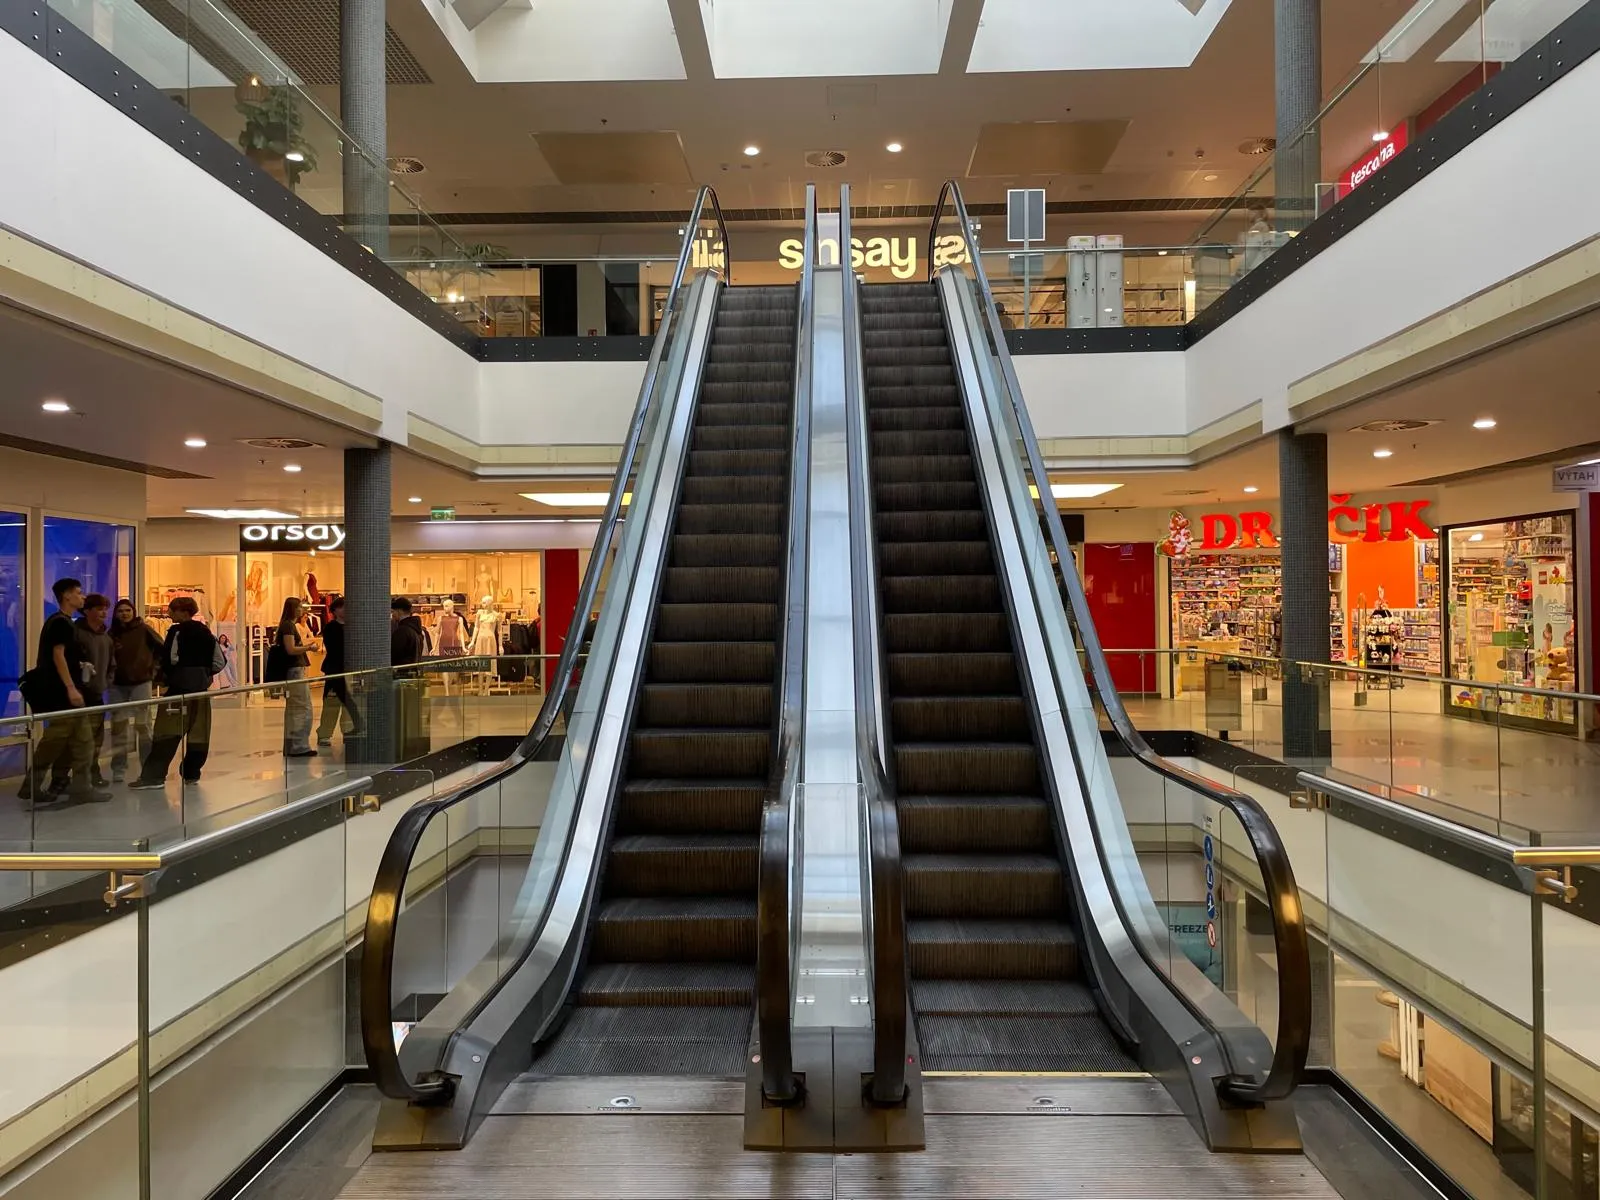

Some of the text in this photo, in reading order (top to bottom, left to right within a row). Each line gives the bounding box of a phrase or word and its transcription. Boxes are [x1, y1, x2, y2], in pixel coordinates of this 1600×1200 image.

[778, 237, 917, 279] snsay
[242, 524, 346, 551] orsay
[1200, 494, 1430, 550] DRČIK
